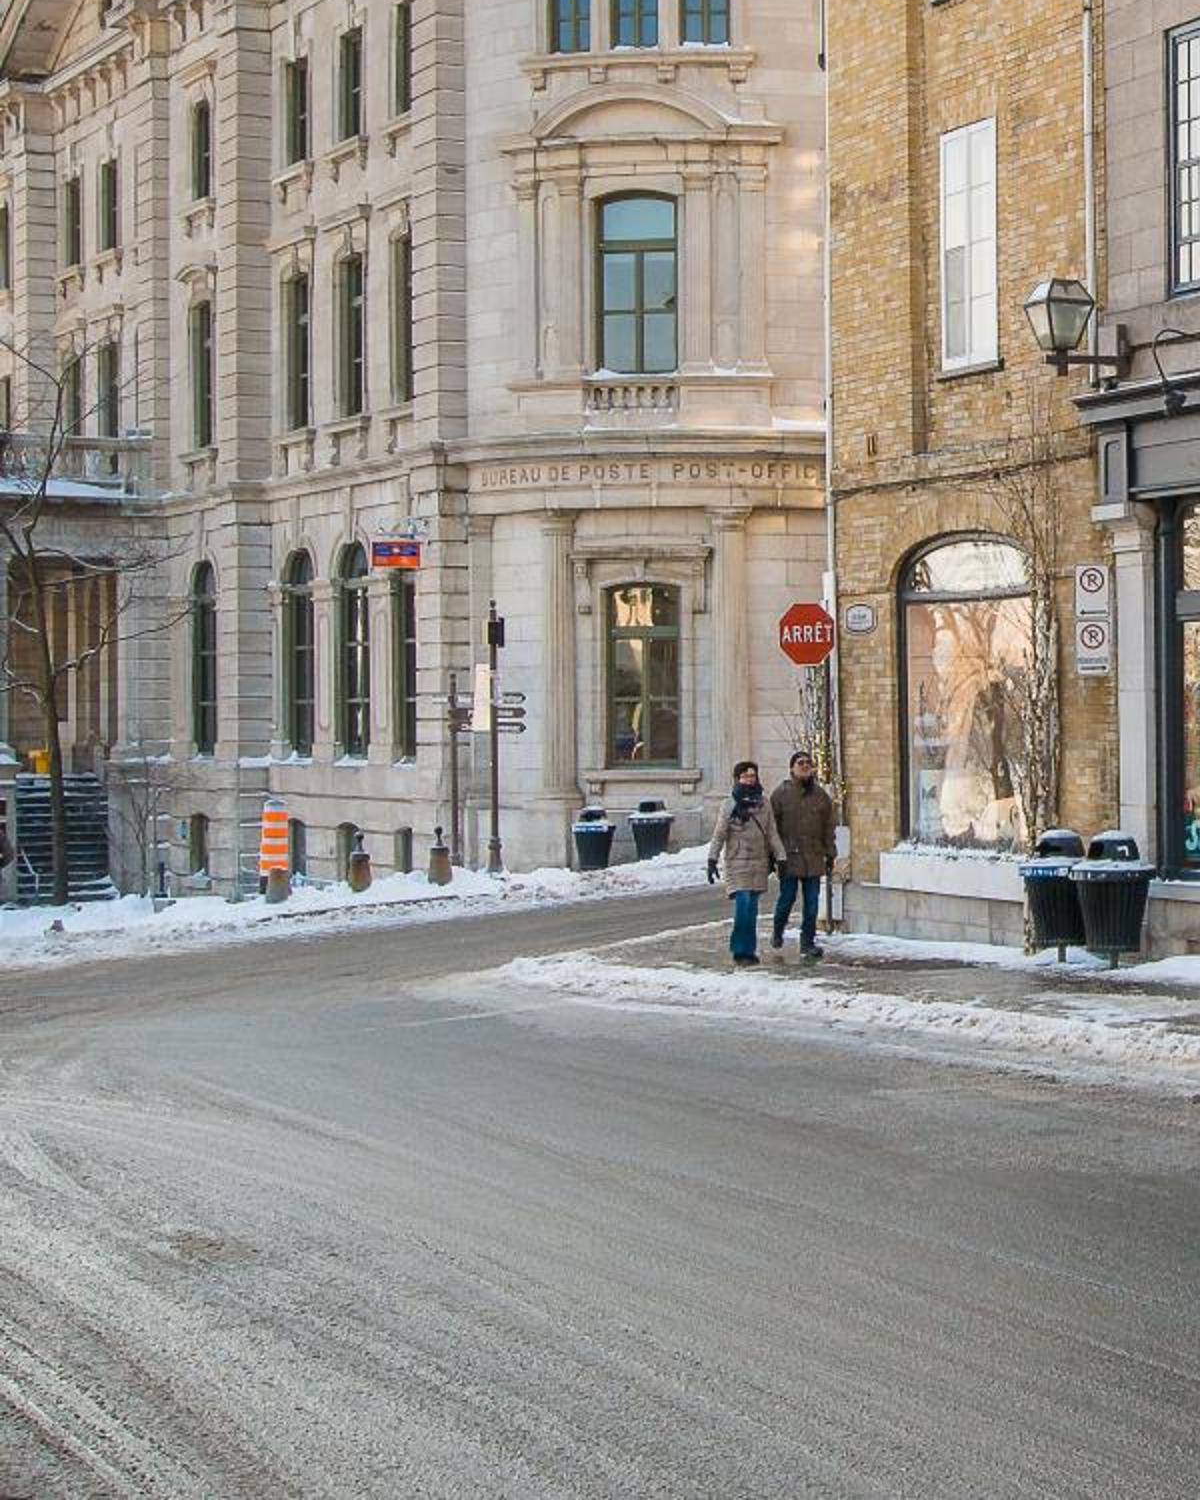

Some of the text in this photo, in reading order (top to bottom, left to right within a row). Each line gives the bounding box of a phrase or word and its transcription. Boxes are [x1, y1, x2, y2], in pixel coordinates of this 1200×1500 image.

[481, 463, 650, 487] BUREAU DE POSTE
[672, 462, 826, 479] POST-OFFIC
[782, 621, 832, 643] ARRÊT
